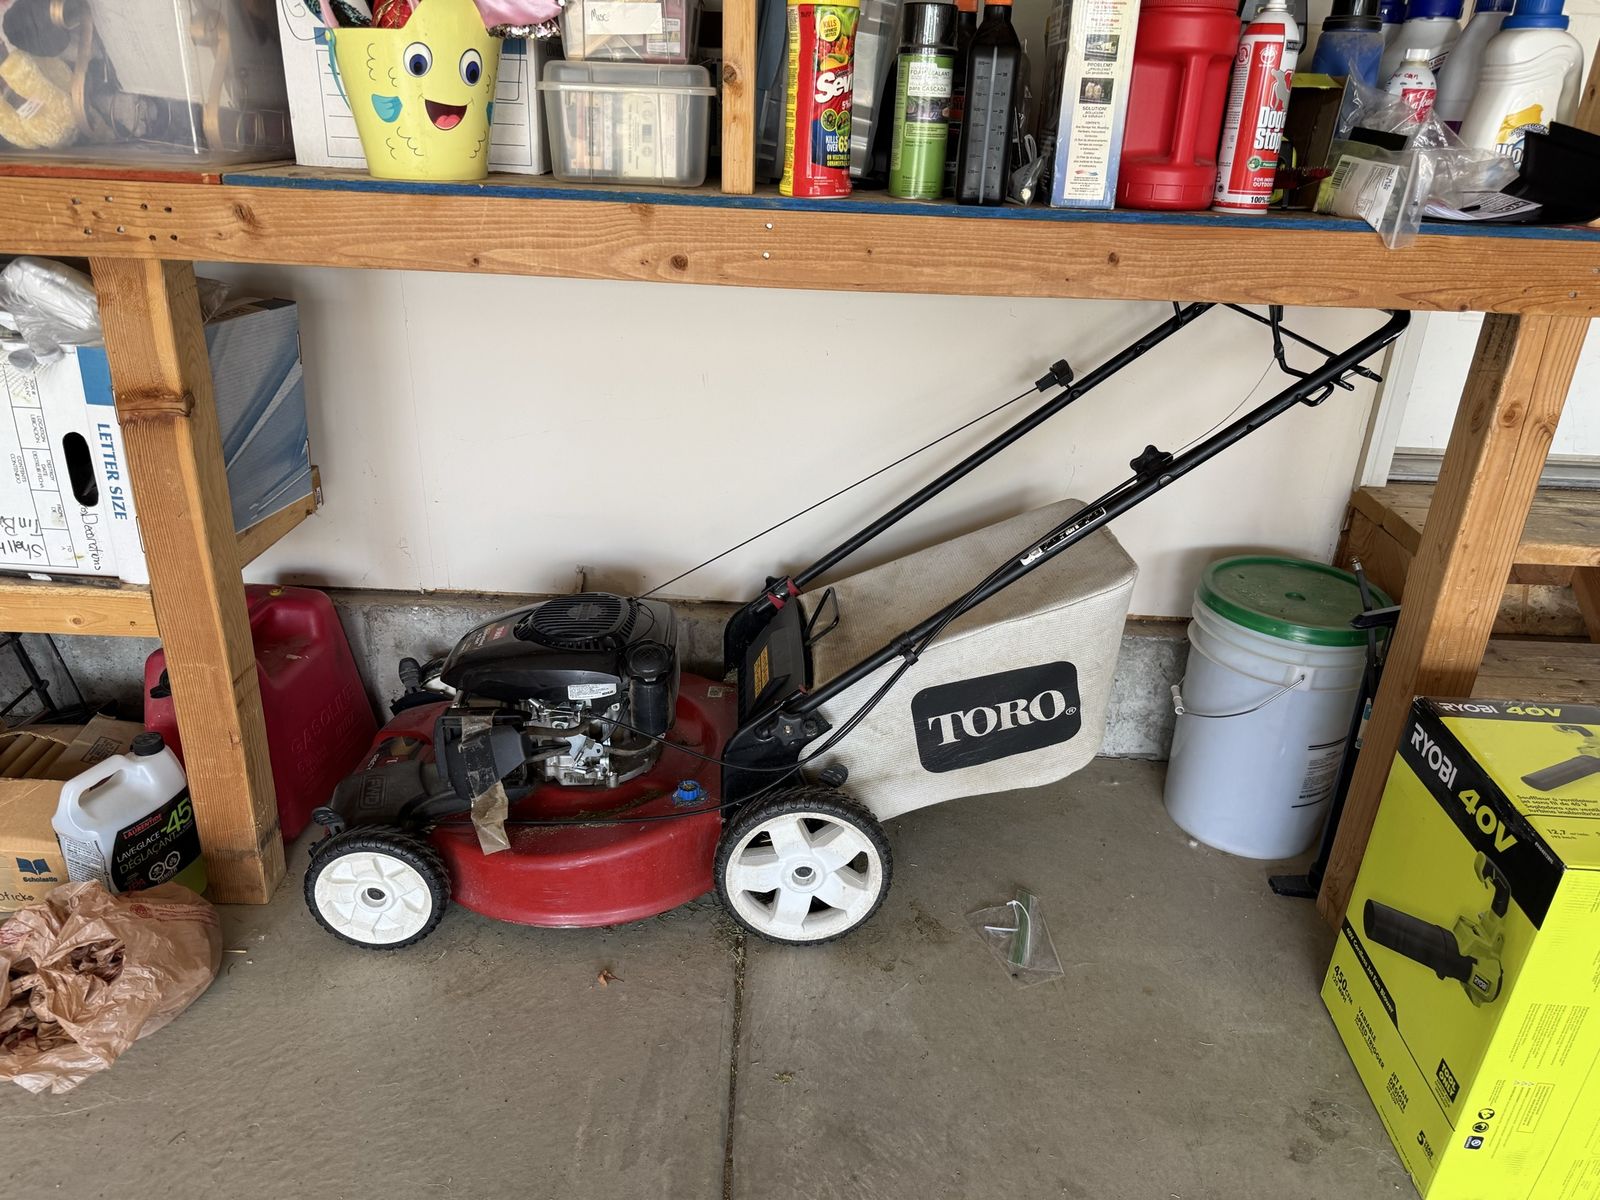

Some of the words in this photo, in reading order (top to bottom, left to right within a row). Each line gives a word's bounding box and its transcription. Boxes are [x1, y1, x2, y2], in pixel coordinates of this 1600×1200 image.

[36, 415, 46, 443] LOCATION
[97, 423, 119, 481] LETTER
[109, 486, 127, 521] SIZE
[291, 680, 356, 754] GASOLINE
[928, 689, 1066, 746] TORO
[1439, 702, 1499, 714] RYOBI
[1506, 706, 1561, 718] 40V
[1411, 723, 1458, 791] RYOBI
[1458, 789, 1518, 853] 40V
[1334, 965, 1349, 990] 450
[1358, 1006, 1377, 1042] VARIABLE
[1366, 1036, 1385, 1070] TRIGGER
[1438, 1071, 1456, 1098] ONLY
[1440, 1063, 1459, 1093] TOOL
[1416, 1130, 1426, 1146] 5
